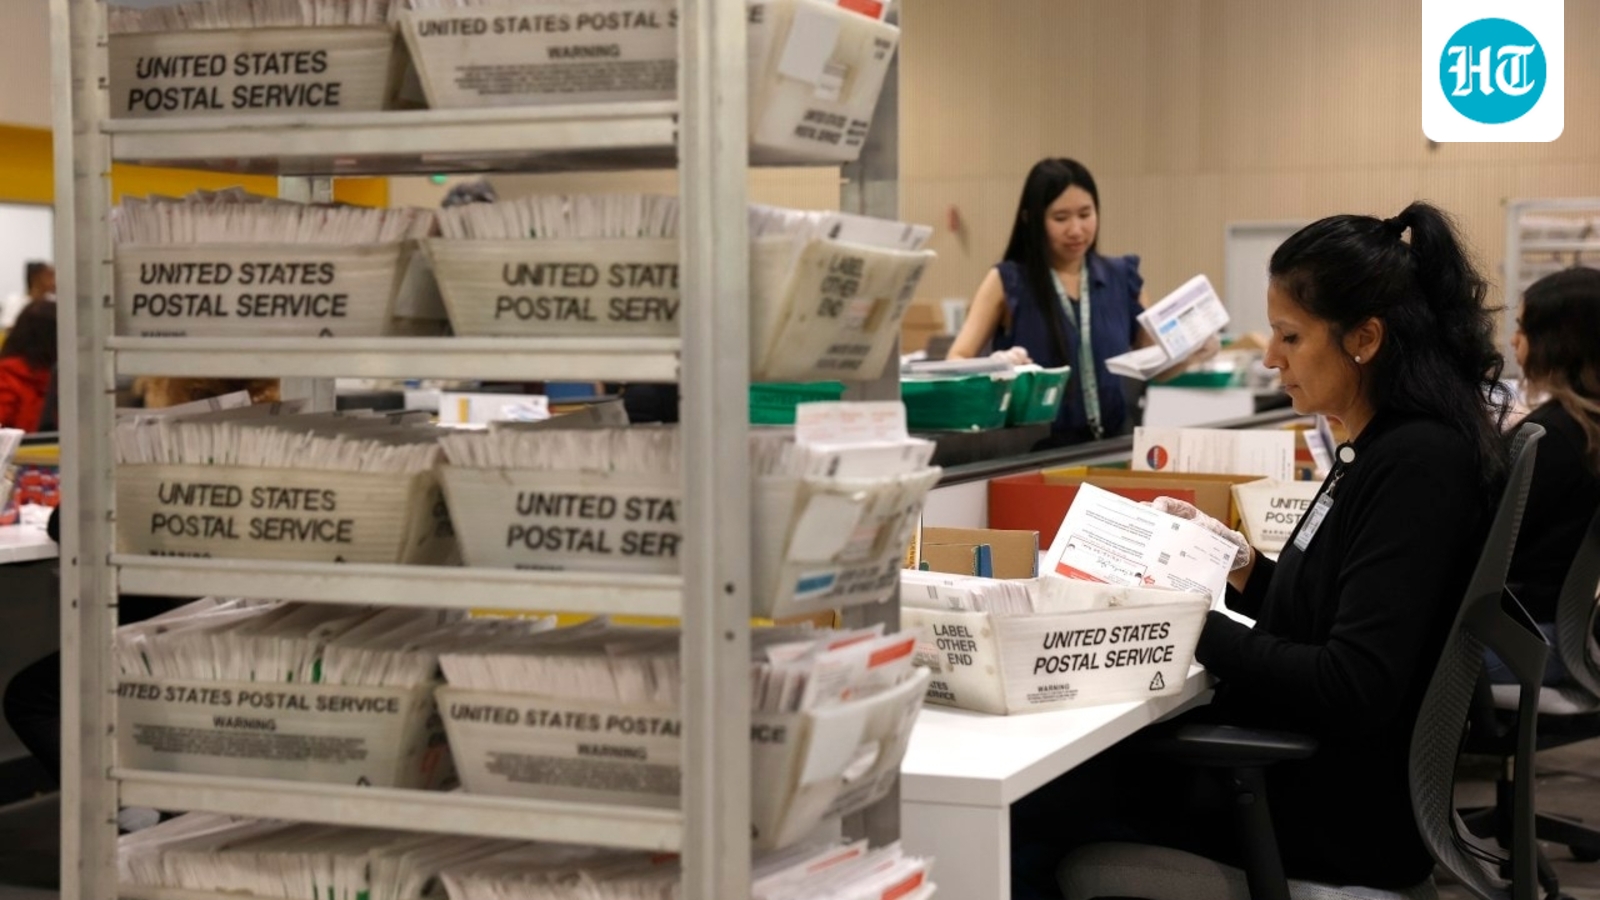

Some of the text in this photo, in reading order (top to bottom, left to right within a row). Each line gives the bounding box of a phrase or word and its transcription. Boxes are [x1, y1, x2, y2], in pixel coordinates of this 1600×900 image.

[419, 17, 487, 37] UNITED
[493, 14, 571, 34] STATES
[576, 11, 659, 31] POSTAL
[136, 50, 327, 80] UNITED STATES
[128, 82, 341, 112] POSTAL SERVICE
[140, 262, 335, 285] UNITED STATES
[502, 262, 599, 288] UNITED
[132, 294, 348, 317] POSTAL SERVICE
[495, 296, 680, 322] POSTAL SERV
[158, 482, 337, 511] UNITED STATES
[515, 492, 617, 520] UNITED
[1270, 497, 1311, 511] UNITE
[150, 513, 353, 543] POSTAL SERVICE
[1265, 511, 1303, 524] POST
[506, 525, 612, 554] POSTAL
[933, 624, 973, 638] LABEL
[1043, 622, 1171, 650] UNITED STATES
[936, 638, 978, 652] OTHER
[947, 653, 973, 666] END
[1033, 645, 1174, 675] POSTAL SERVICE
[164, 686, 232, 706] STATES
[238, 692, 309, 711] POSTAL
[316, 695, 399, 714] SERVICE
[213, 716, 277, 732] WARNING
[450, 703, 519, 725] UNITED
[525, 708, 600, 731] STATES
